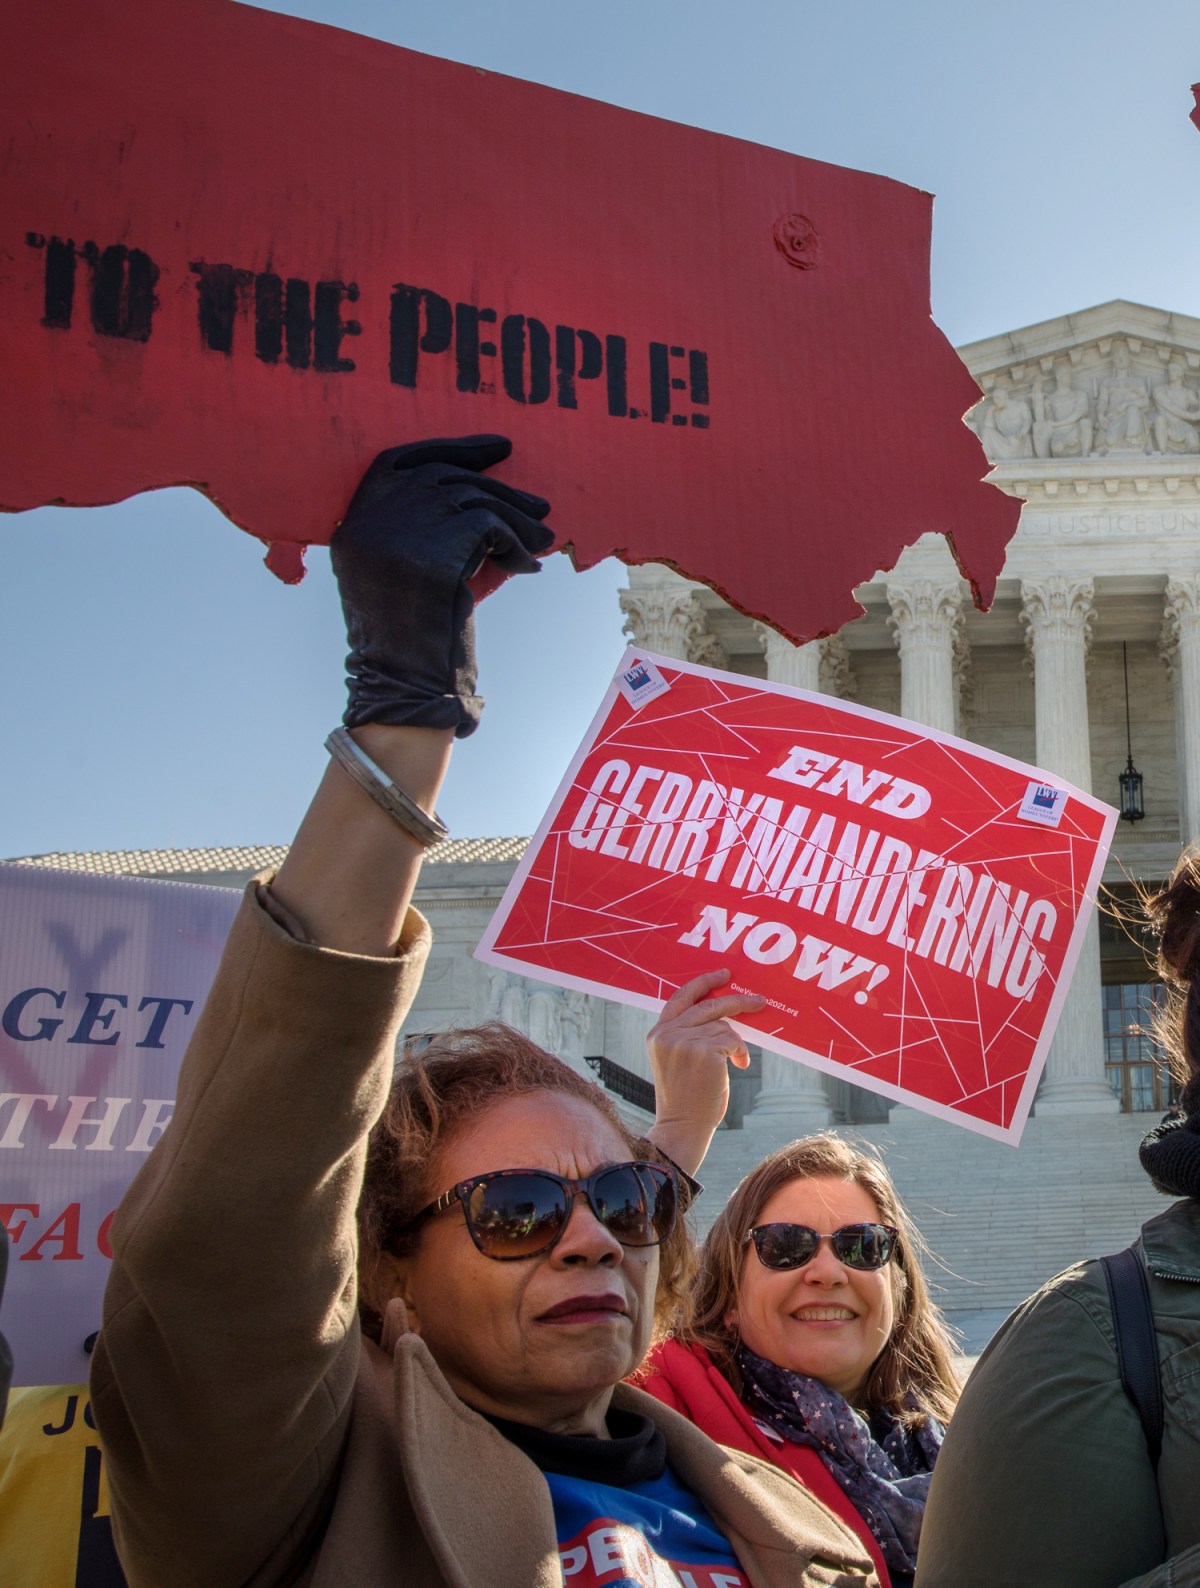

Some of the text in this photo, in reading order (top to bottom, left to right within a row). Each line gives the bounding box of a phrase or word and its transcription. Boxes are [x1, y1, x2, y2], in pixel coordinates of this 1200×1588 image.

[25, 232, 710, 429] TO THE PEOPLE!
[1042, 513, 1147, 536] JUSTICE
[766, 745, 932, 820] END
[567, 758, 1059, 1002] GERRYMANDERING
[677, 905, 890, 1005] NOW!
[2, 987, 194, 1049] GET
[0, 1092, 176, 1152] THE
